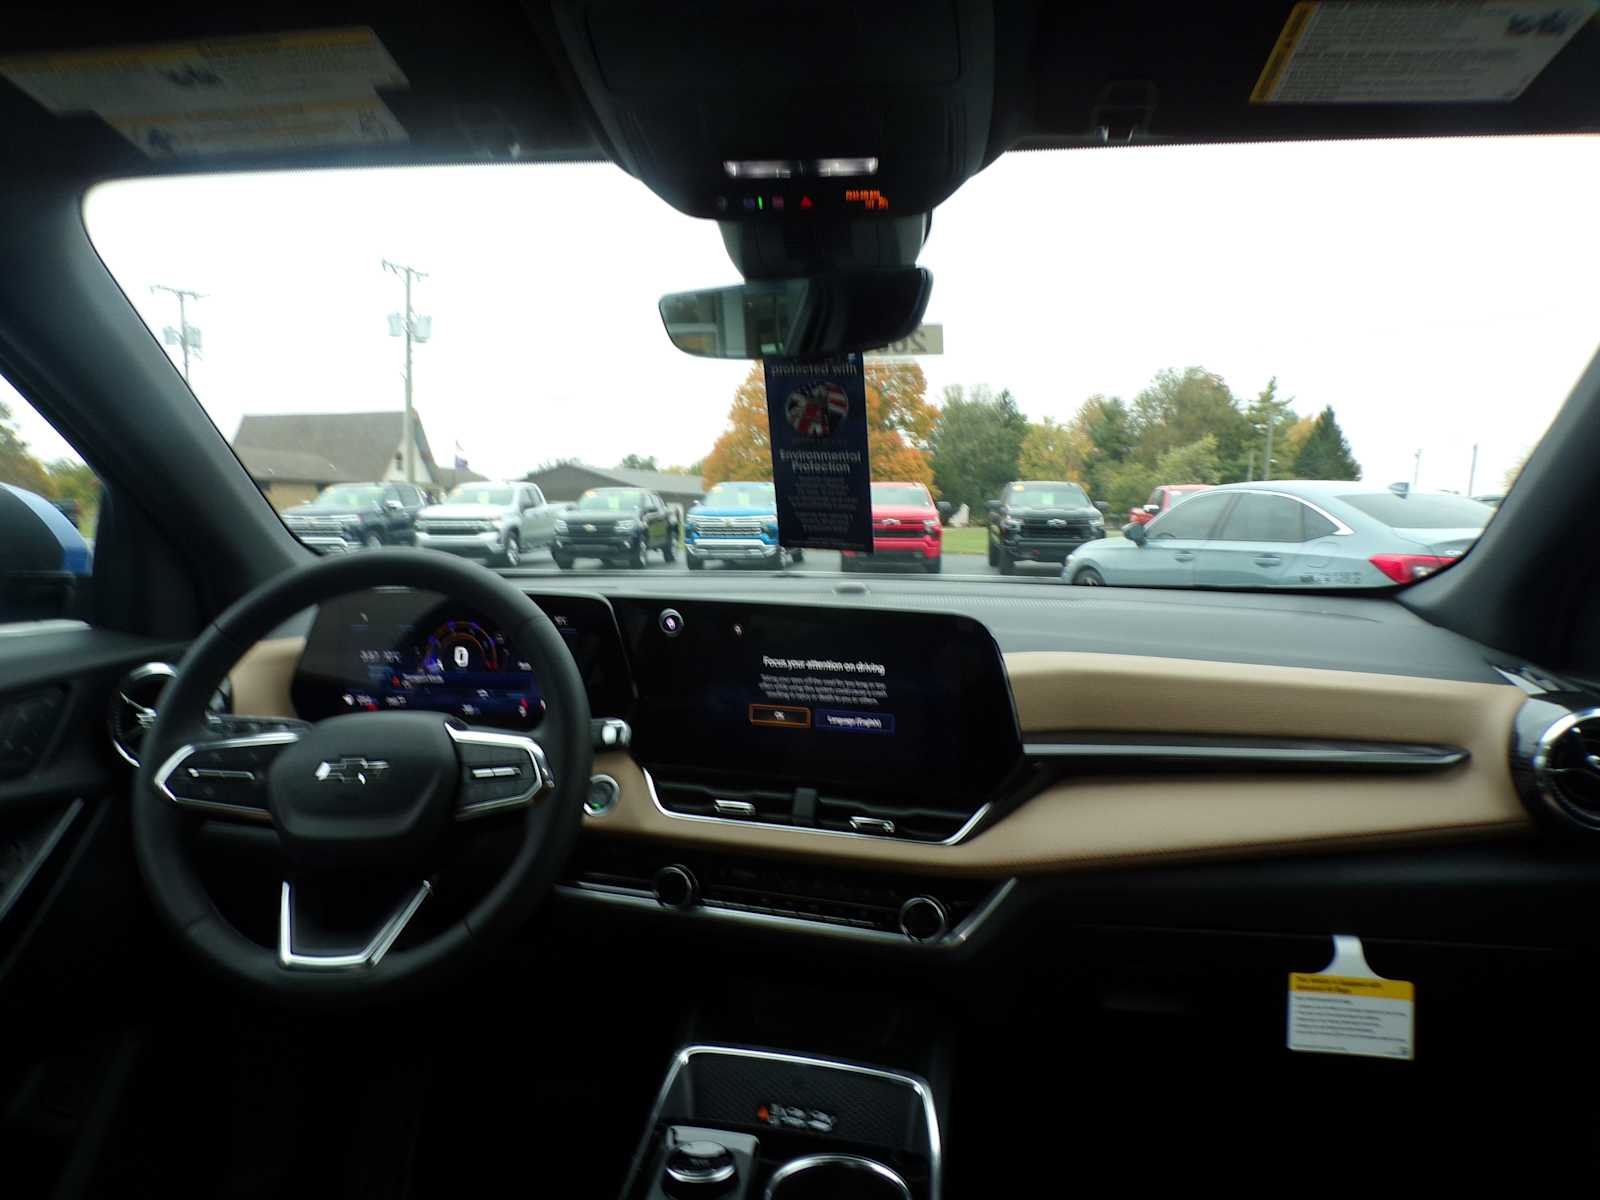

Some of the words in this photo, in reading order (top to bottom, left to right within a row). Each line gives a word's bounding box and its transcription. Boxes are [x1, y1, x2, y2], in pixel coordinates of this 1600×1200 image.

[832, 362, 858, 376] with
[780, 448, 862, 463] Environmental
[791, 461, 851, 473] Protection
[763, 655, 787, 669] Focus
[787, 659, 806, 671] your
[806, 659, 843, 672] attention
[843, 662, 857, 672] on
[856, 661, 886, 676] driving
